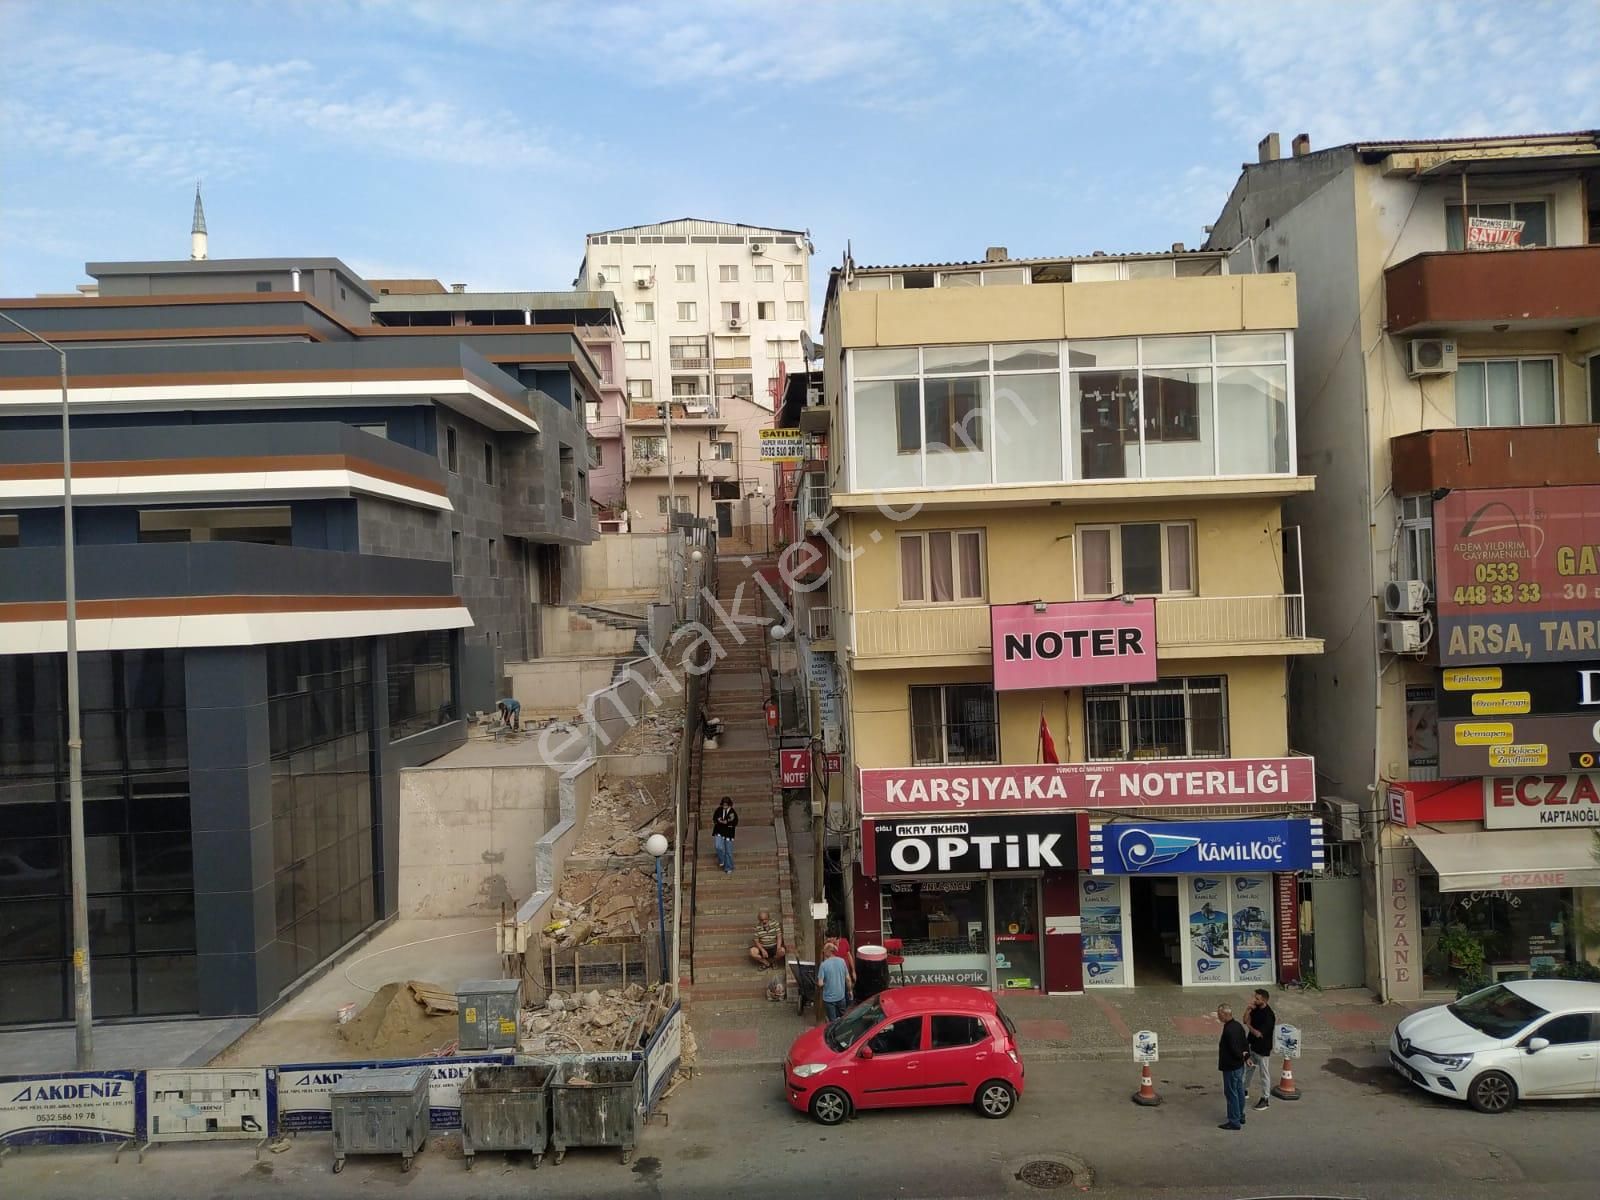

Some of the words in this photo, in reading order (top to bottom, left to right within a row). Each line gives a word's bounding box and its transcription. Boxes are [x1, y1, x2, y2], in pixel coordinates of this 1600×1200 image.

[1470, 228, 1518, 244] SATILIK
[1453, 543, 1482, 552] ADEM
[1556, 545, 1600, 577] GA
[1475, 563, 1519, 583] 0533
[1453, 585, 1486, 605] 448
[1491, 584, 1513, 605] 33
[1518, 583, 1541, 603] 33
[1563, 583, 1587, 600] 30
[1004, 627, 1146, 662] NOTER
[1447, 624, 1532, 659] ARSA,
[886, 775, 1067, 808] KARŞIYAKA
[1085, 774, 1105, 798] 7.
[1119, 764, 1289, 797] NOTERLİĞİ
[898, 826, 927, 835] AKAY
[931, 824, 967, 834] AKHAN
[1460, 888, 1522, 910] ECZANE
[1392, 878, 1410, 982] ECZANE
[890, 975, 918, 984] AKAY
[920, 974, 954, 984] AKHAN
[956, 972, 984, 982] OPTİK
[36, 1114, 56, 1122] 0532
[86, 1112, 95, 1120] 78
